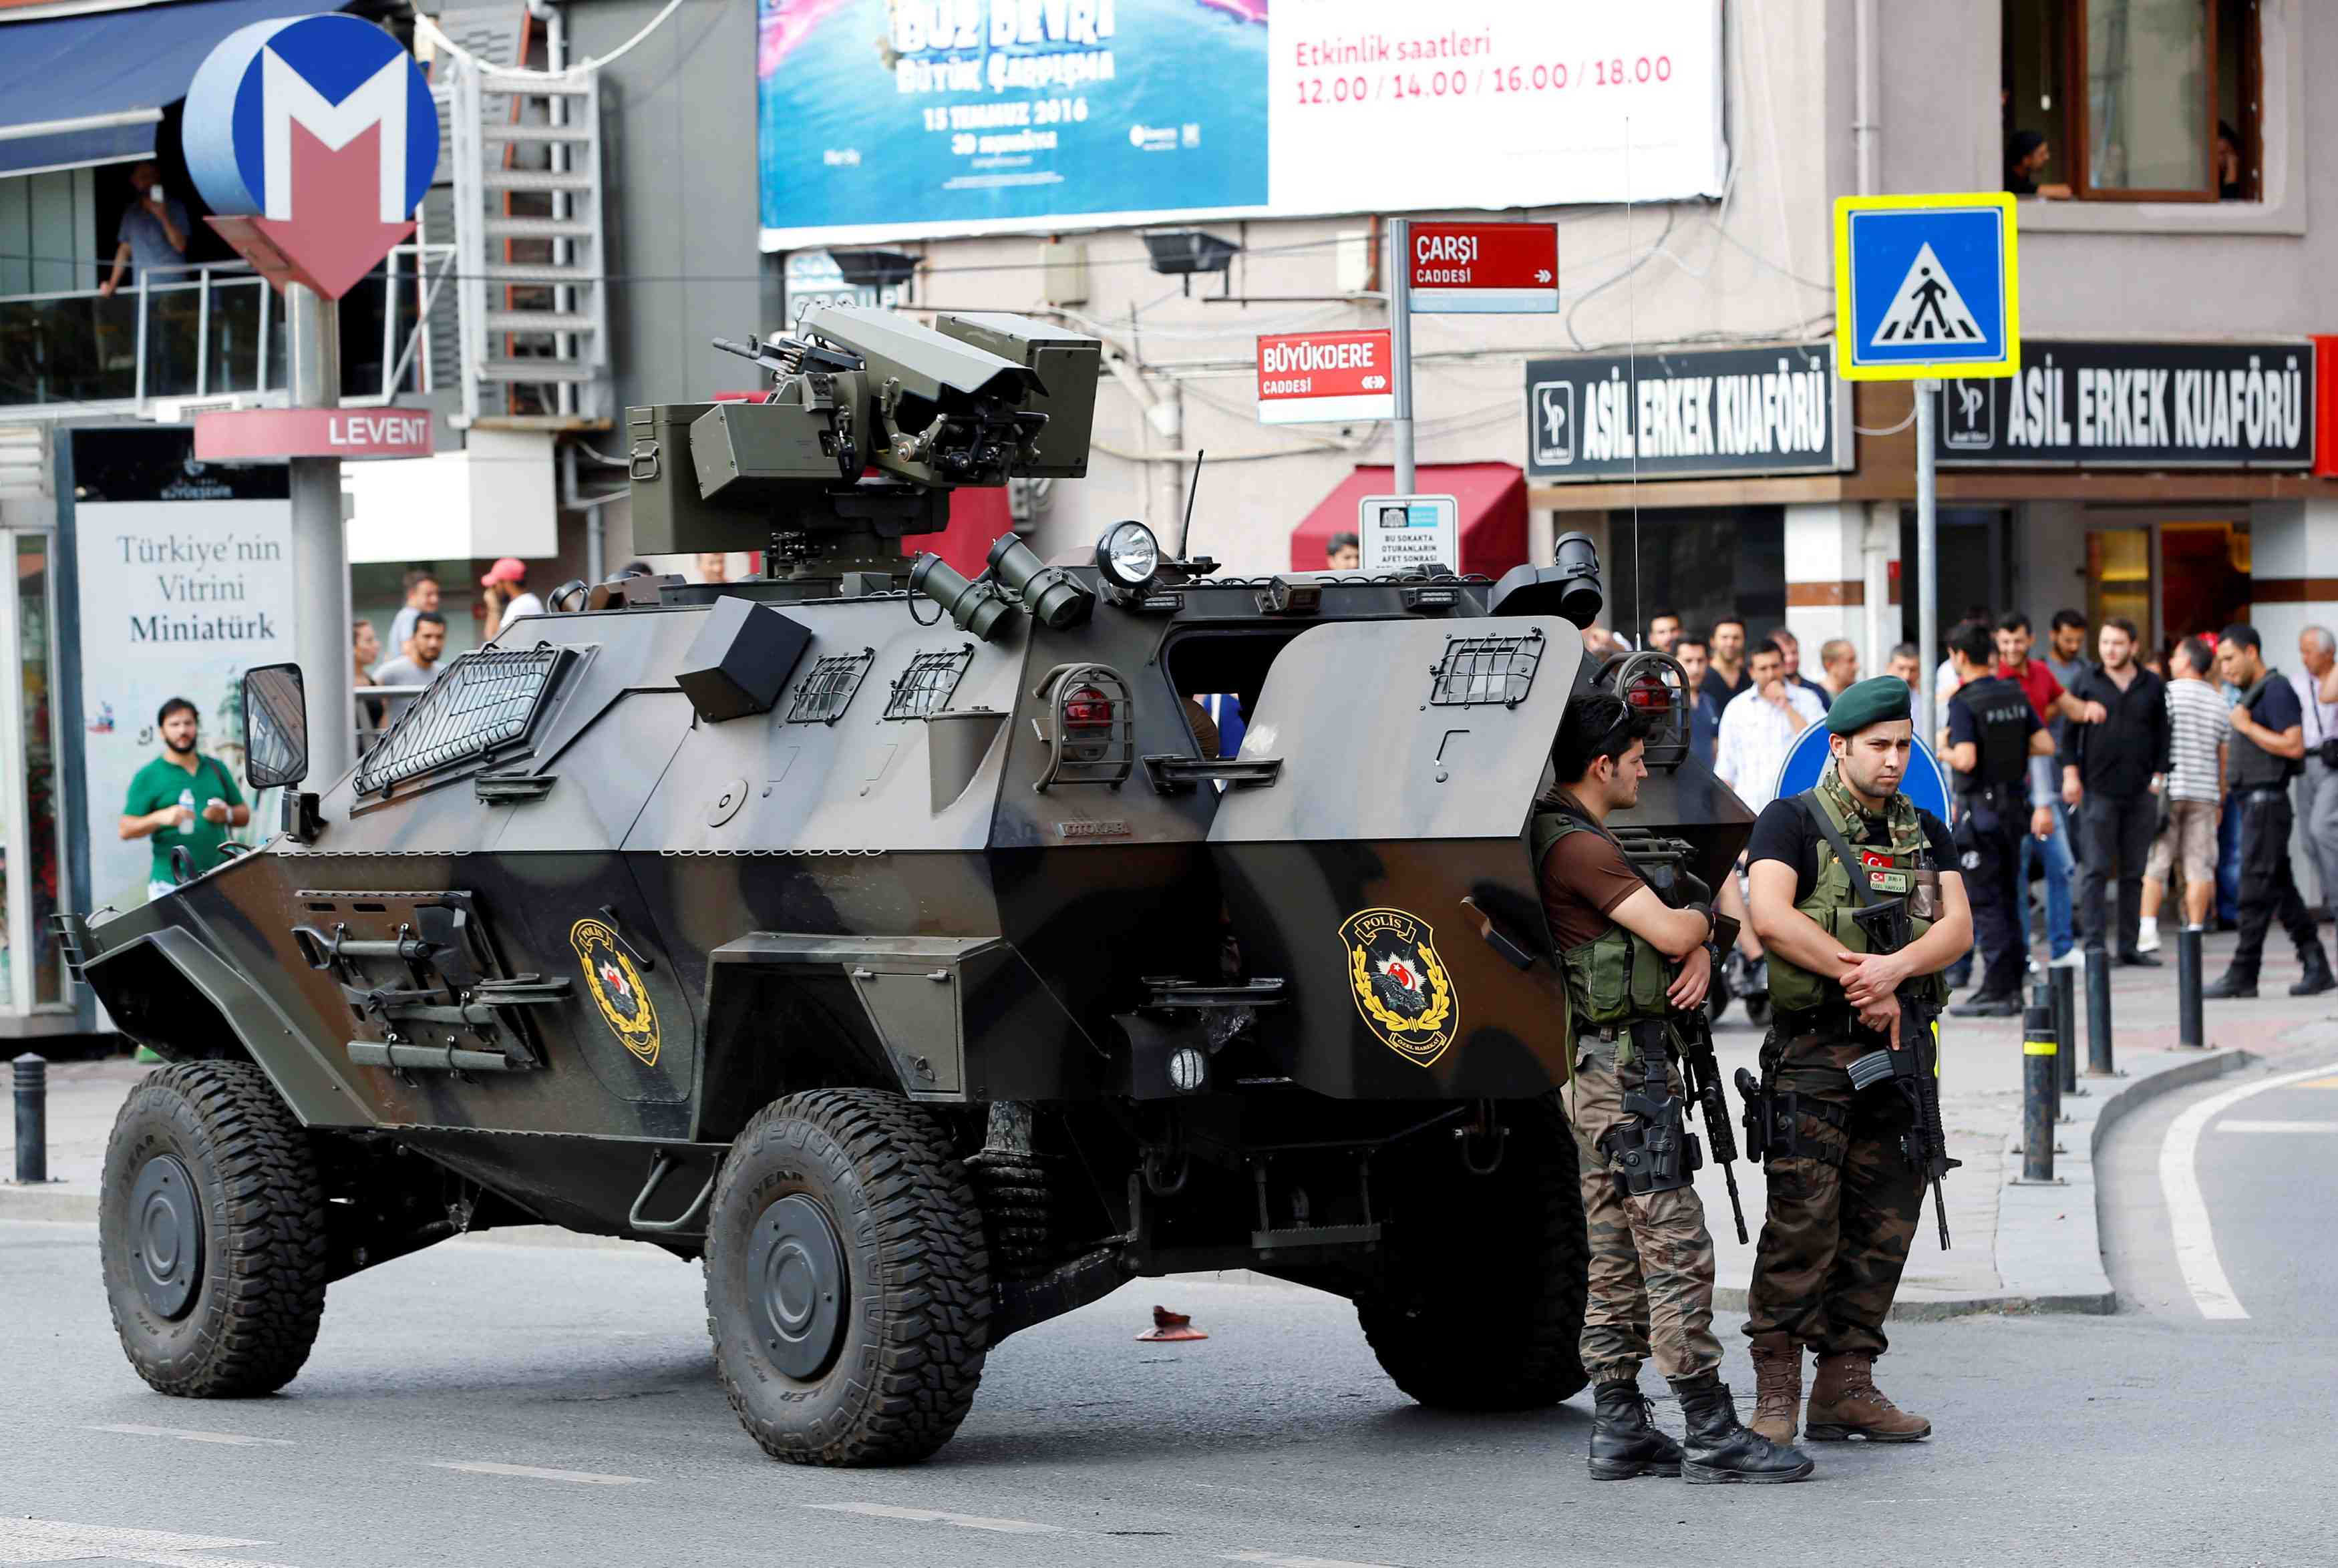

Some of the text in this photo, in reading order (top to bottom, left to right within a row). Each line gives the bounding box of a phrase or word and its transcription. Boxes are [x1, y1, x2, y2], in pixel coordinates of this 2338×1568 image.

[1297, 29, 1490, 66] Etkinlik saatleri
[1297, 77, 1367, 104] 12.00
[1394, 70, 1466, 98] 14.00
[1493, 63, 1568, 91] 16.00
[1595, 56, 1671, 85] 18.00
[923, 106, 948, 132] 15
[1033, 96, 1088, 126] 2016
[1416, 235, 1478, 265] ÇARŞI
[1416, 266, 1472, 283] CADDESİ
[1263, 341, 1375, 373] BÜYÜKDERE
[1263, 376, 1312, 395] CADDESİ
[2007, 352, 2302, 449] ASİL ERKEK KUAFÖRÜ
[1582, 355, 1826, 461] ASİL ERKEK KUAFÖRÜ
[329, 416, 426, 445] LEVENT
[116, 532, 282, 572] Türkiye'nin
[1397, 534, 1434, 542] SOKAKTA
[157, 572, 245, 601] Vitrini
[130, 611, 276, 642] Miniatürk
[1363, 915, 1401, 930] POLİS
